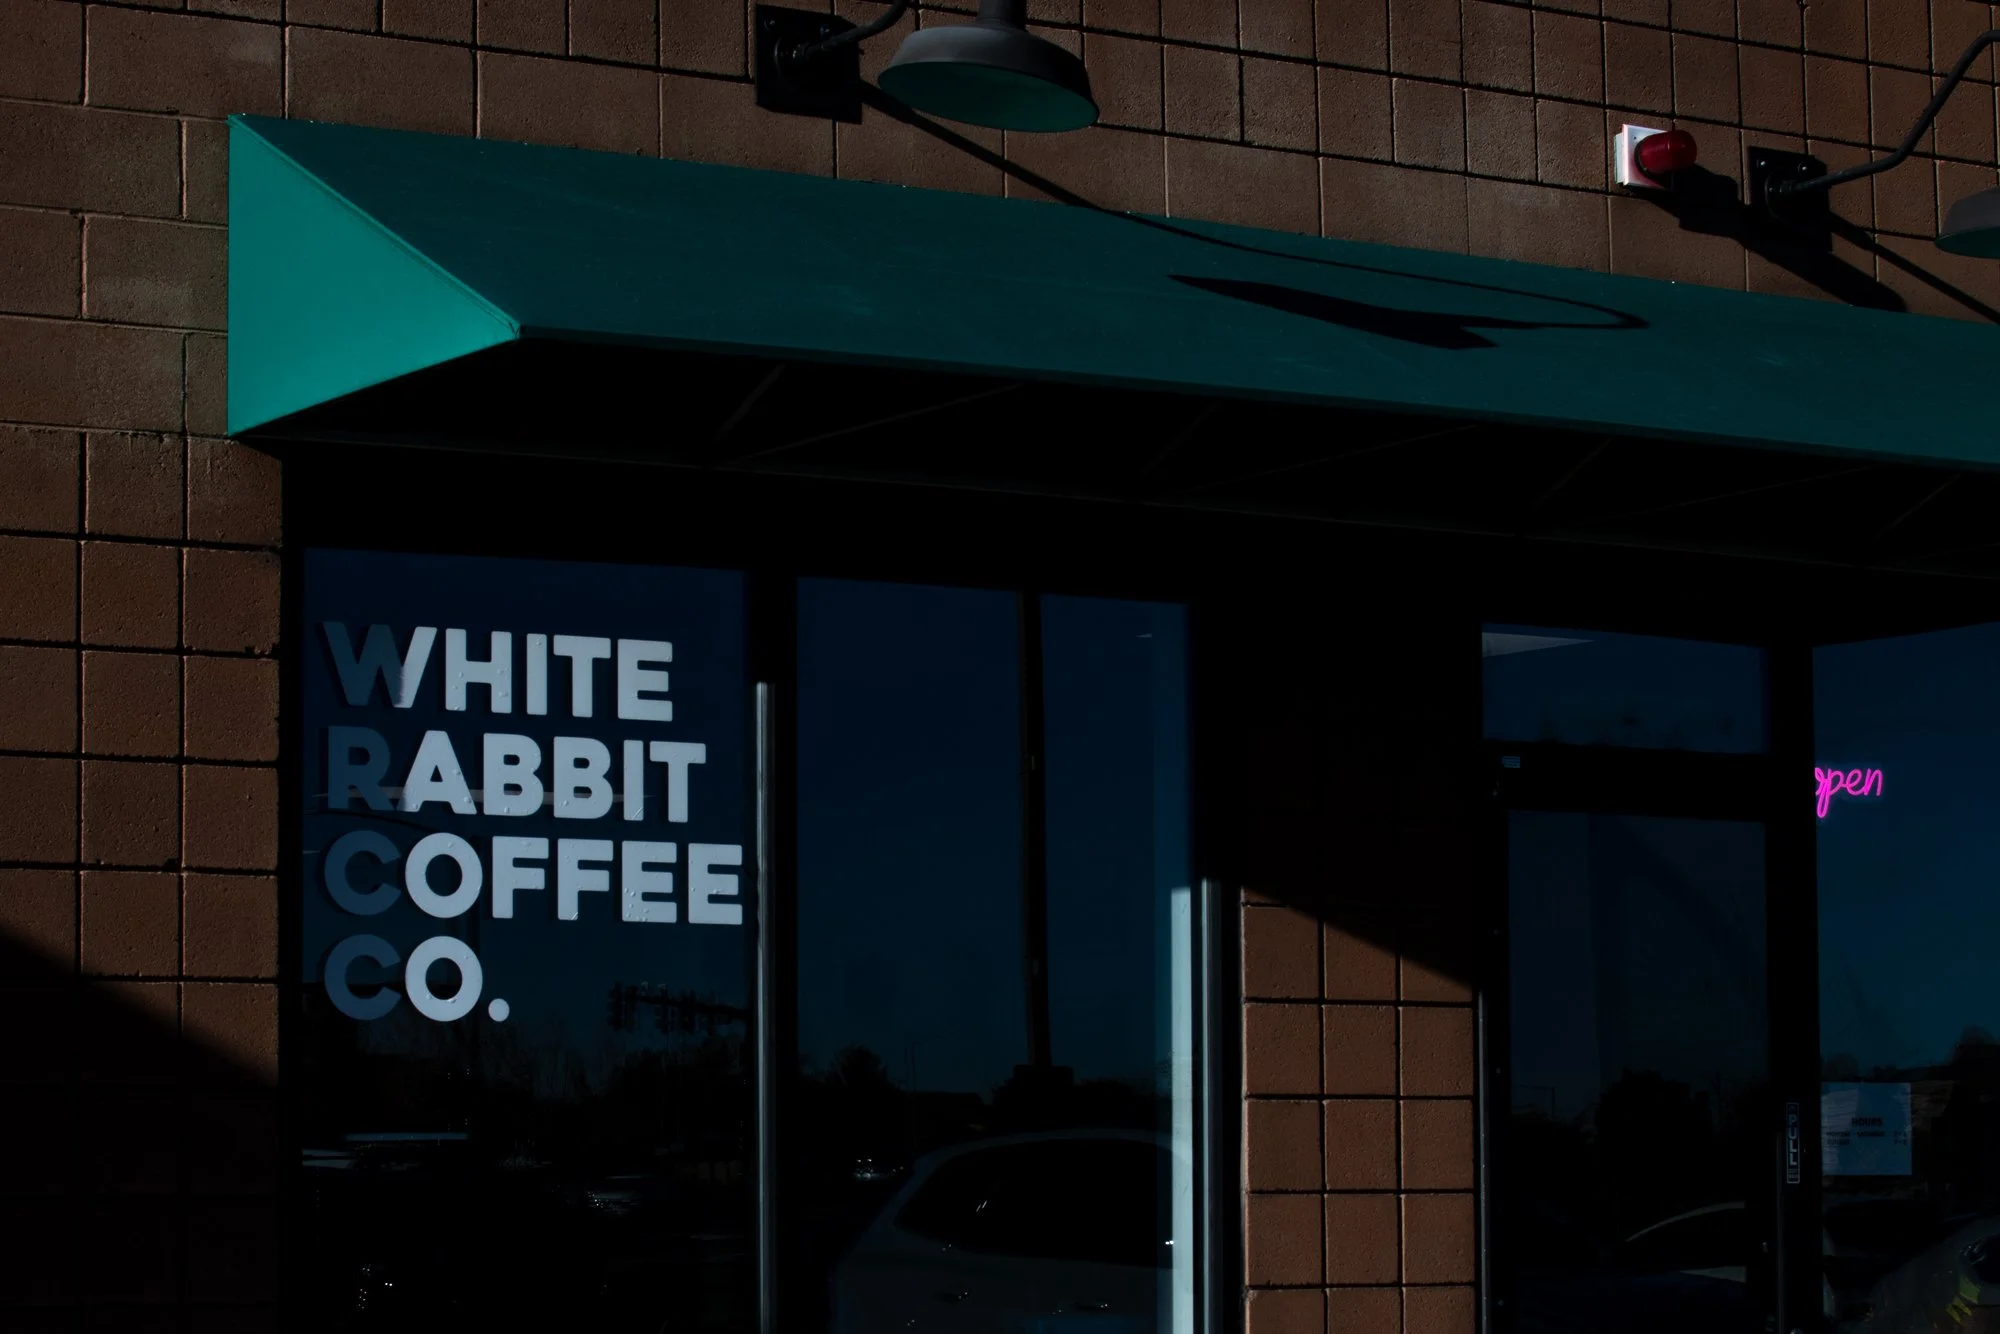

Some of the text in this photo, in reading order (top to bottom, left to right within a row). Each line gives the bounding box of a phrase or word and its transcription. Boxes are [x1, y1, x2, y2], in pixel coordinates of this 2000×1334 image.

[322, 621, 674, 722] WHITE
[327, 725, 707, 823] RABBIT
[323, 829, 743, 926] COFFEE
[323, 933, 511, 1023] CO.
[1788, 1114, 1798, 1166] PULL
